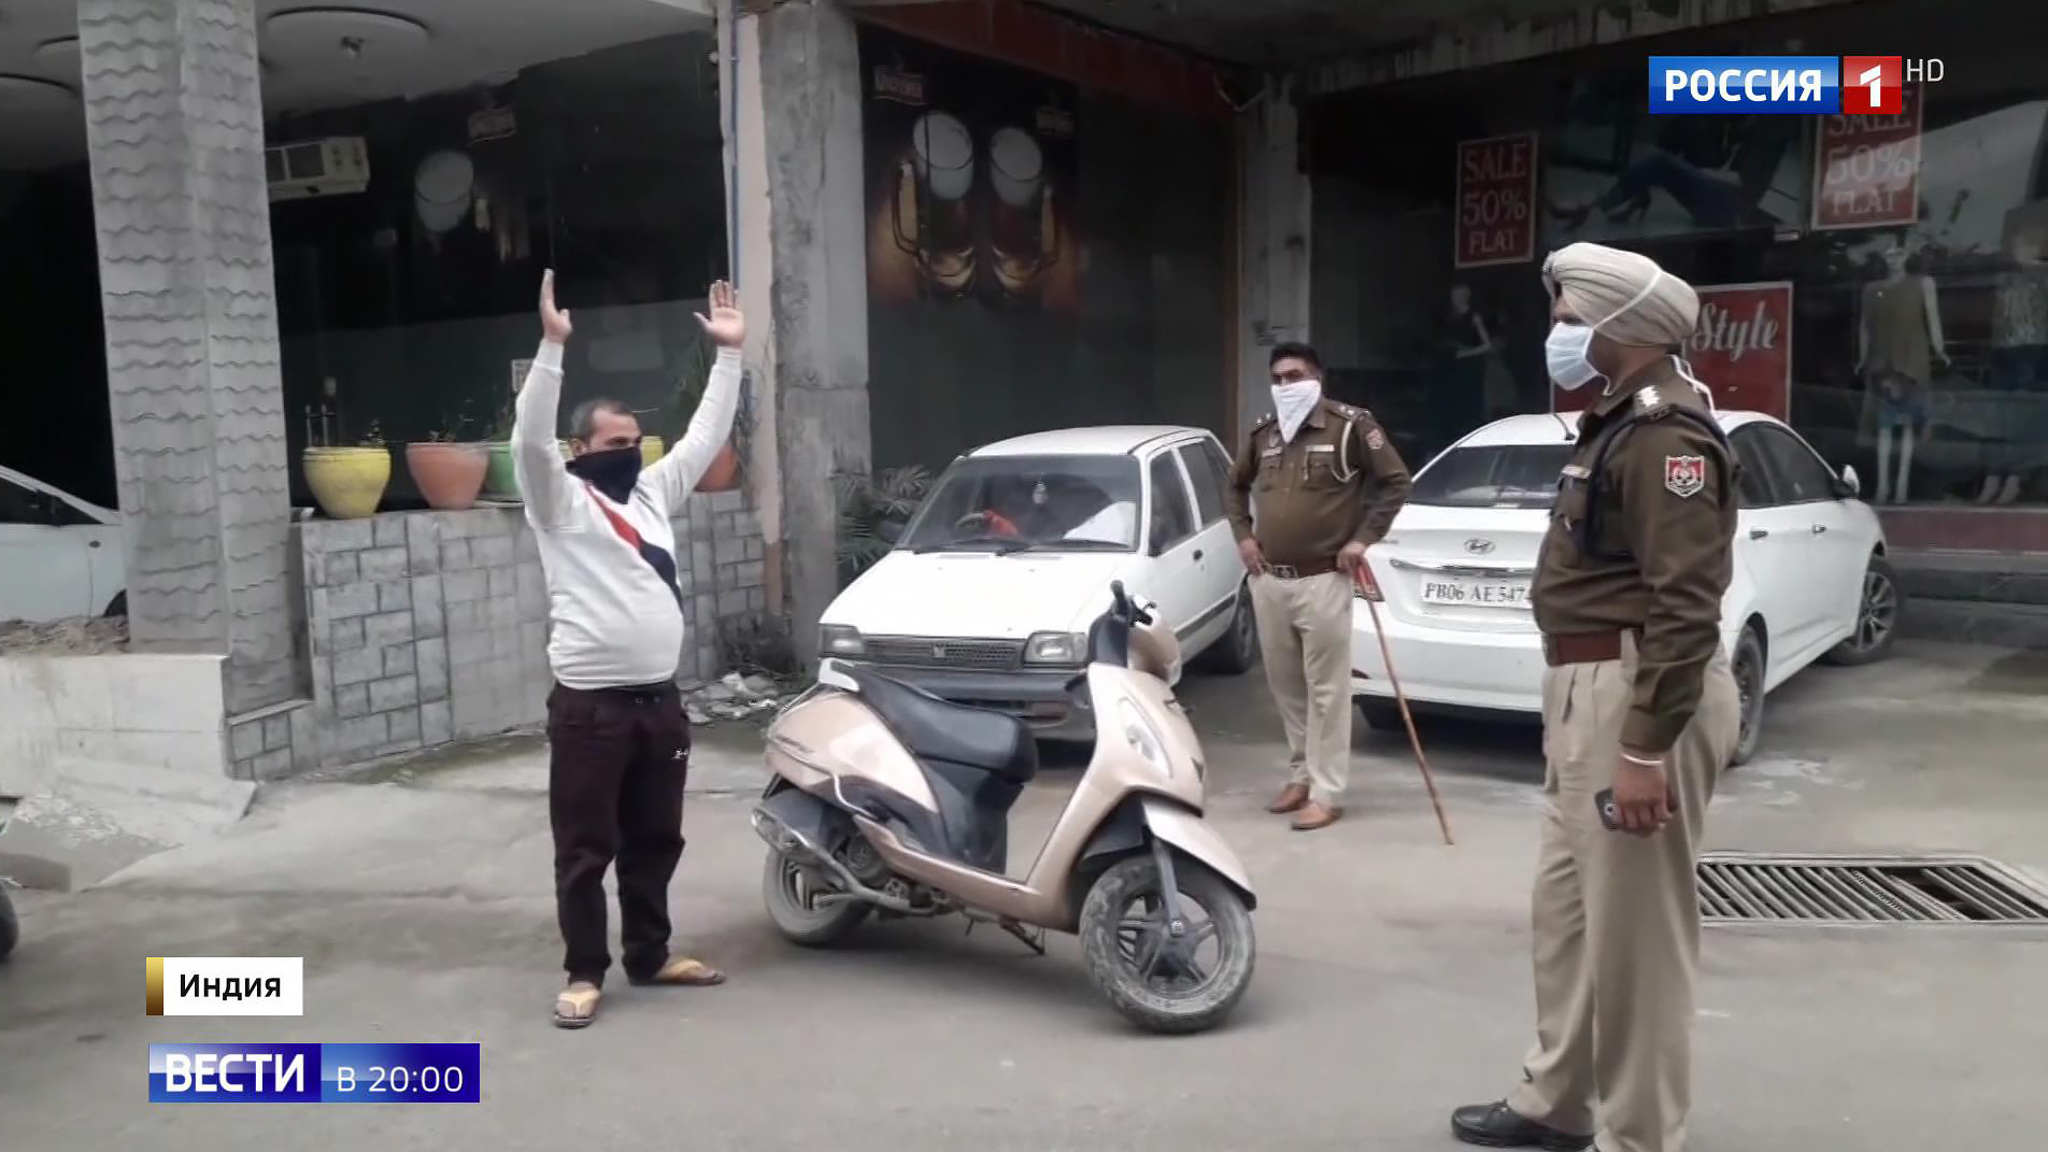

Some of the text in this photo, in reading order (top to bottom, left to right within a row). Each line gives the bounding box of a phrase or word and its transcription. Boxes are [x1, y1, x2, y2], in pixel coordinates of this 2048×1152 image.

[1463, 143, 1527, 182] SALE
[1827, 143, 1910, 185] 50%
[1463, 188, 1527, 226] 50%
[1832, 188, 1896, 215] FLAT
[1468, 226, 1518, 256] FLAT
[1690, 300, 1779, 362] Style
